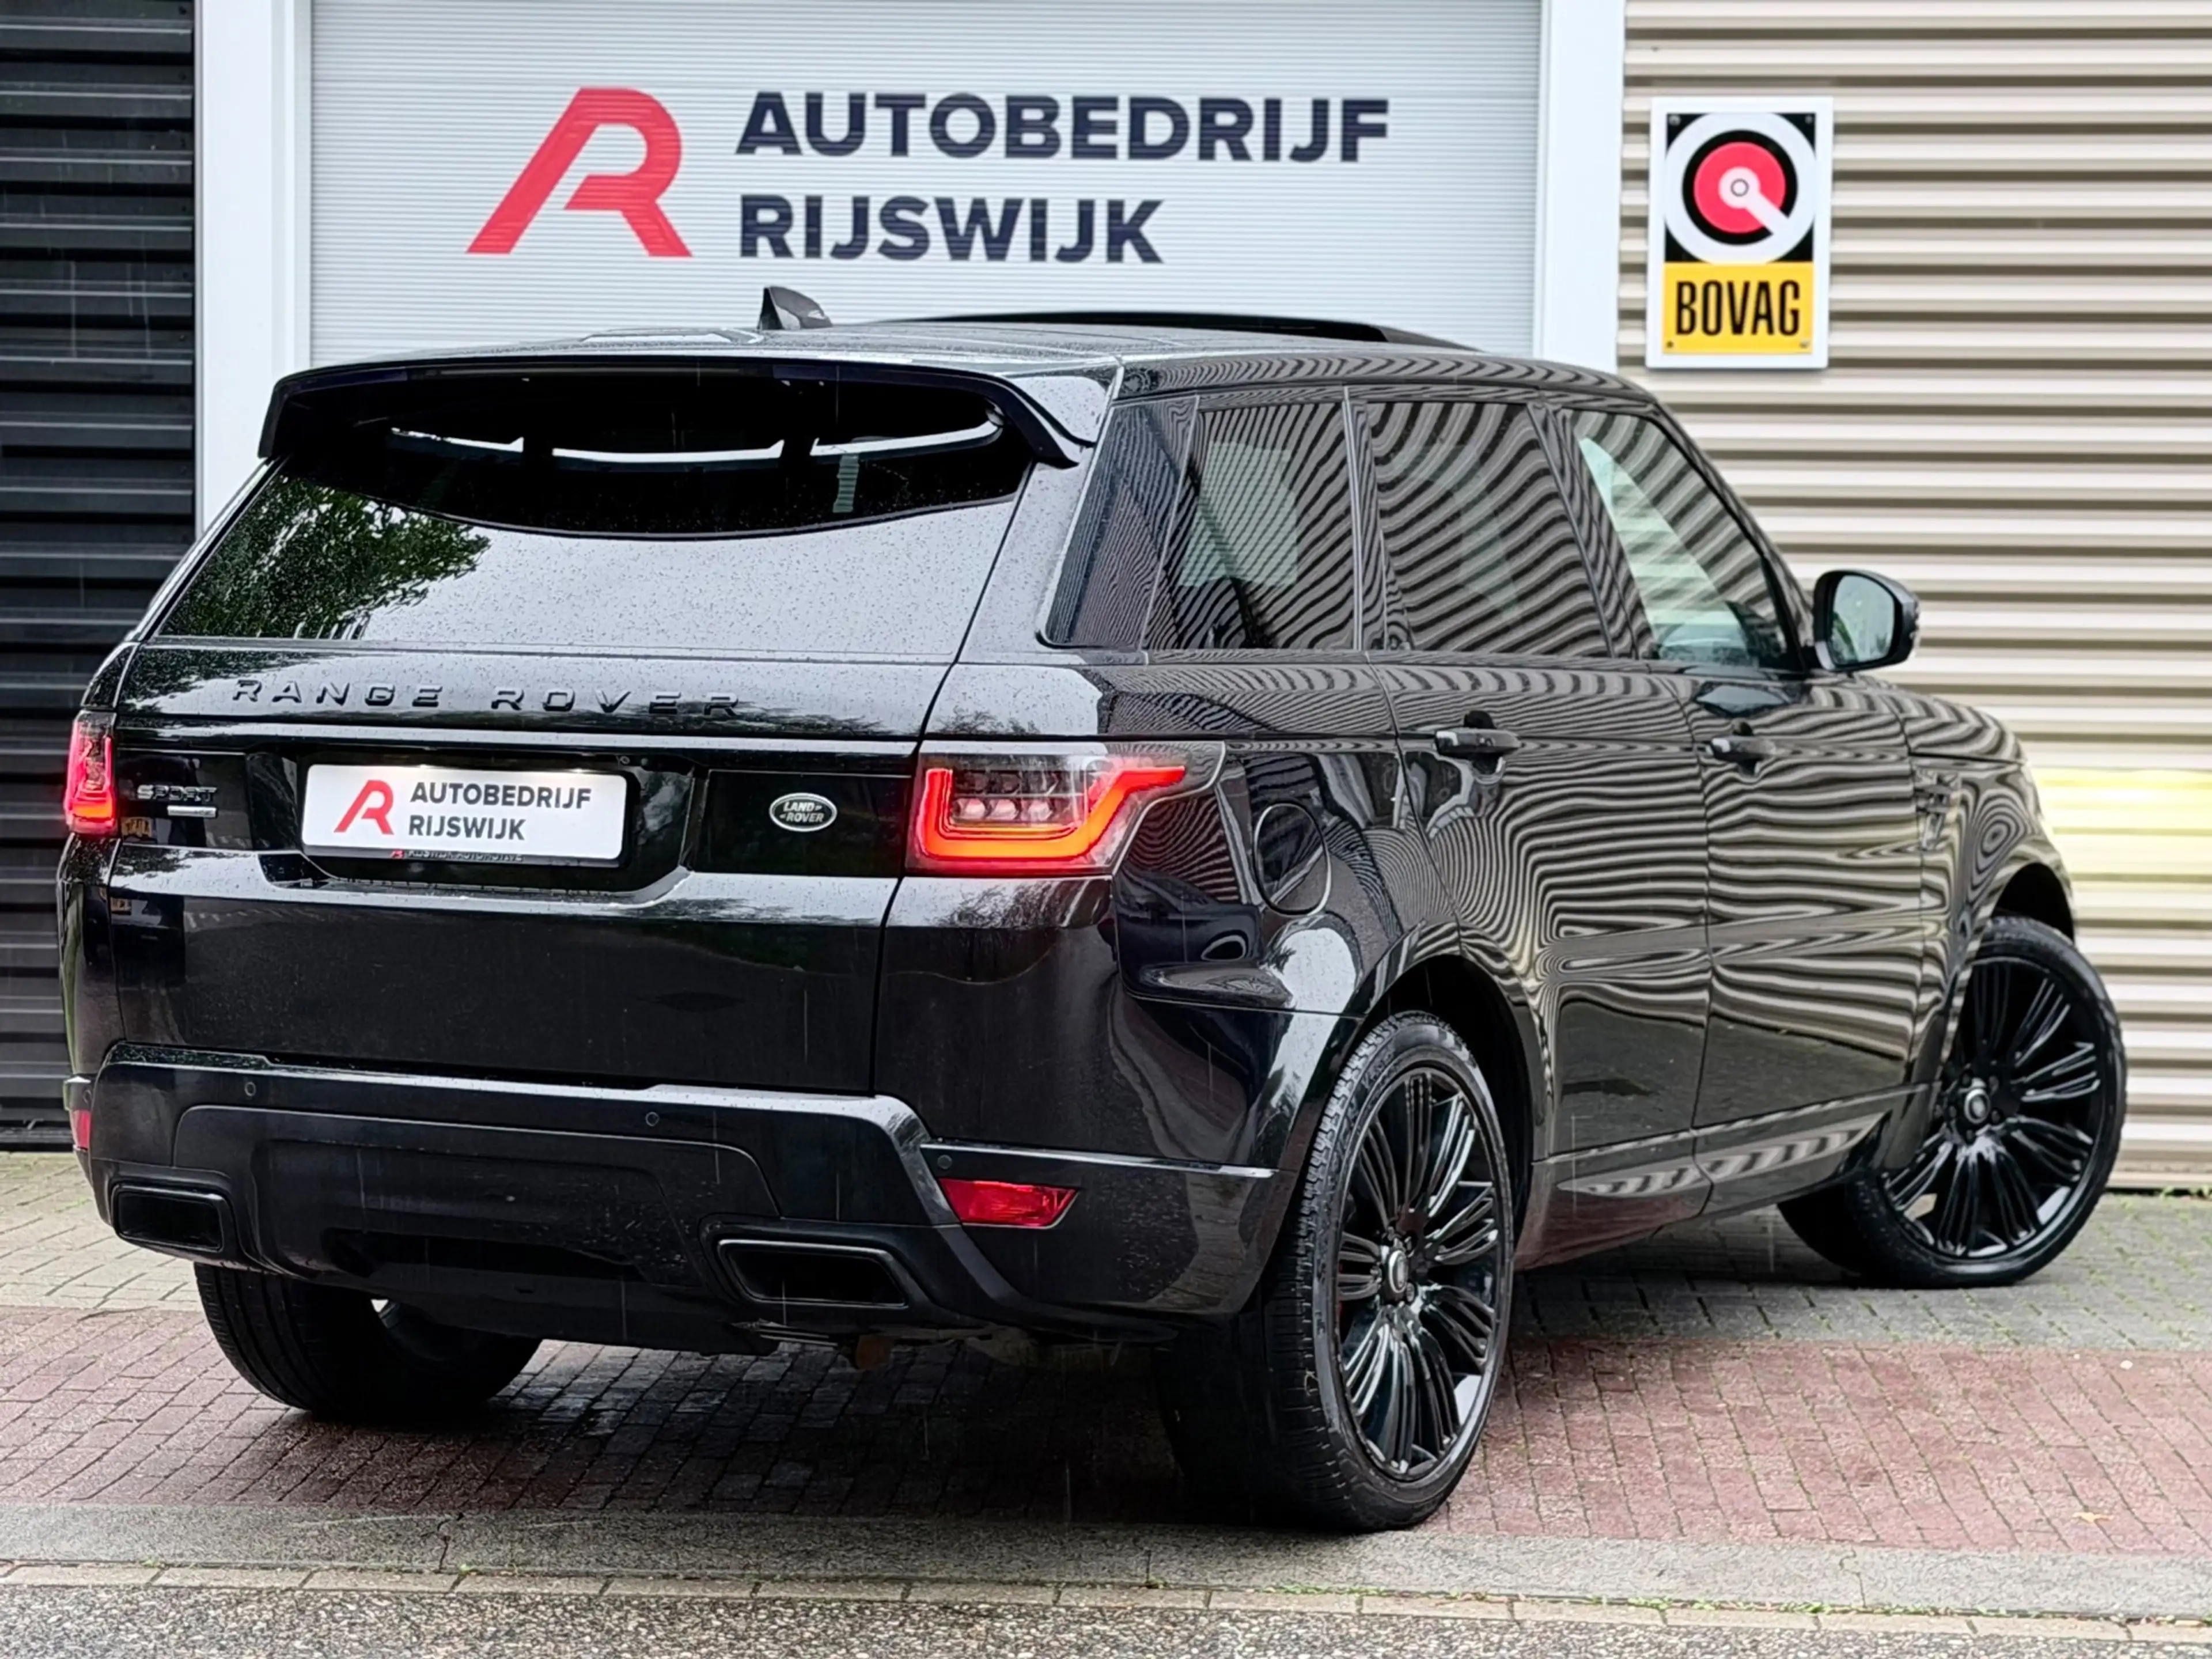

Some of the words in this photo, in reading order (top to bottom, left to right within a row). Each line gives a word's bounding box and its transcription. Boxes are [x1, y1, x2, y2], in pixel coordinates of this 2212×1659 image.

[736, 92, 1388, 162] AUTOBEDRIJF
[741, 195, 1161, 263] RIJSWIJK
[1676, 279, 1800, 336] BOVAG
[232, 679, 443, 707] RANGE
[490, 687, 740, 717] ROVER
[137, 785, 218, 802] SPORT
[410, 782, 592, 809] AUTOBEDRIJF
[783, 801, 815, 812] LAND
[408, 815, 525, 840] RIJSWIJK
[786, 812, 824, 822] ROVER
